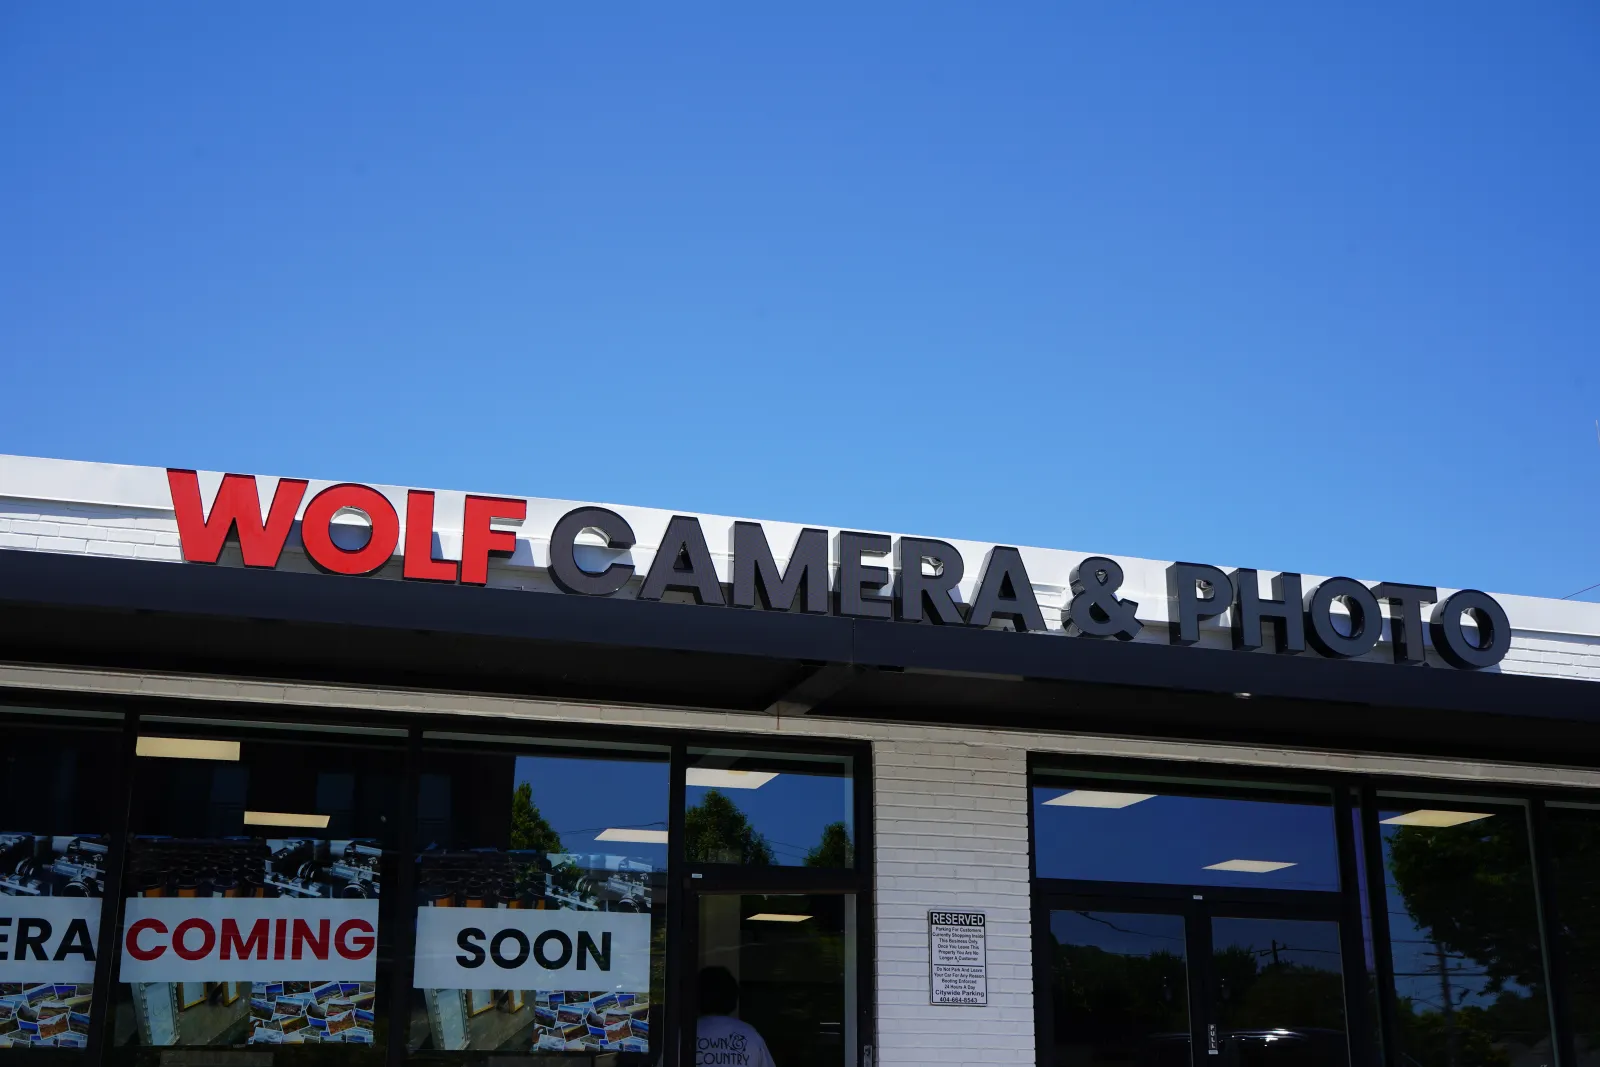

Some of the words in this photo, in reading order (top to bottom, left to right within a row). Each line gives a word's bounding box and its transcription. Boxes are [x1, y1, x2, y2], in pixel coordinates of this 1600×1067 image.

[167, 468, 527, 586] WOLF
[549, 501, 1047, 631] CAMERA
[1061, 556, 1145, 641] &
[1166, 561, 1512, 670] PHOTO
[125, 917, 376, 961] COMING
[932, 913, 984, 925] RESERVED
[455, 927, 612, 971] SOON
[696, 1037, 728, 1050] OWN
